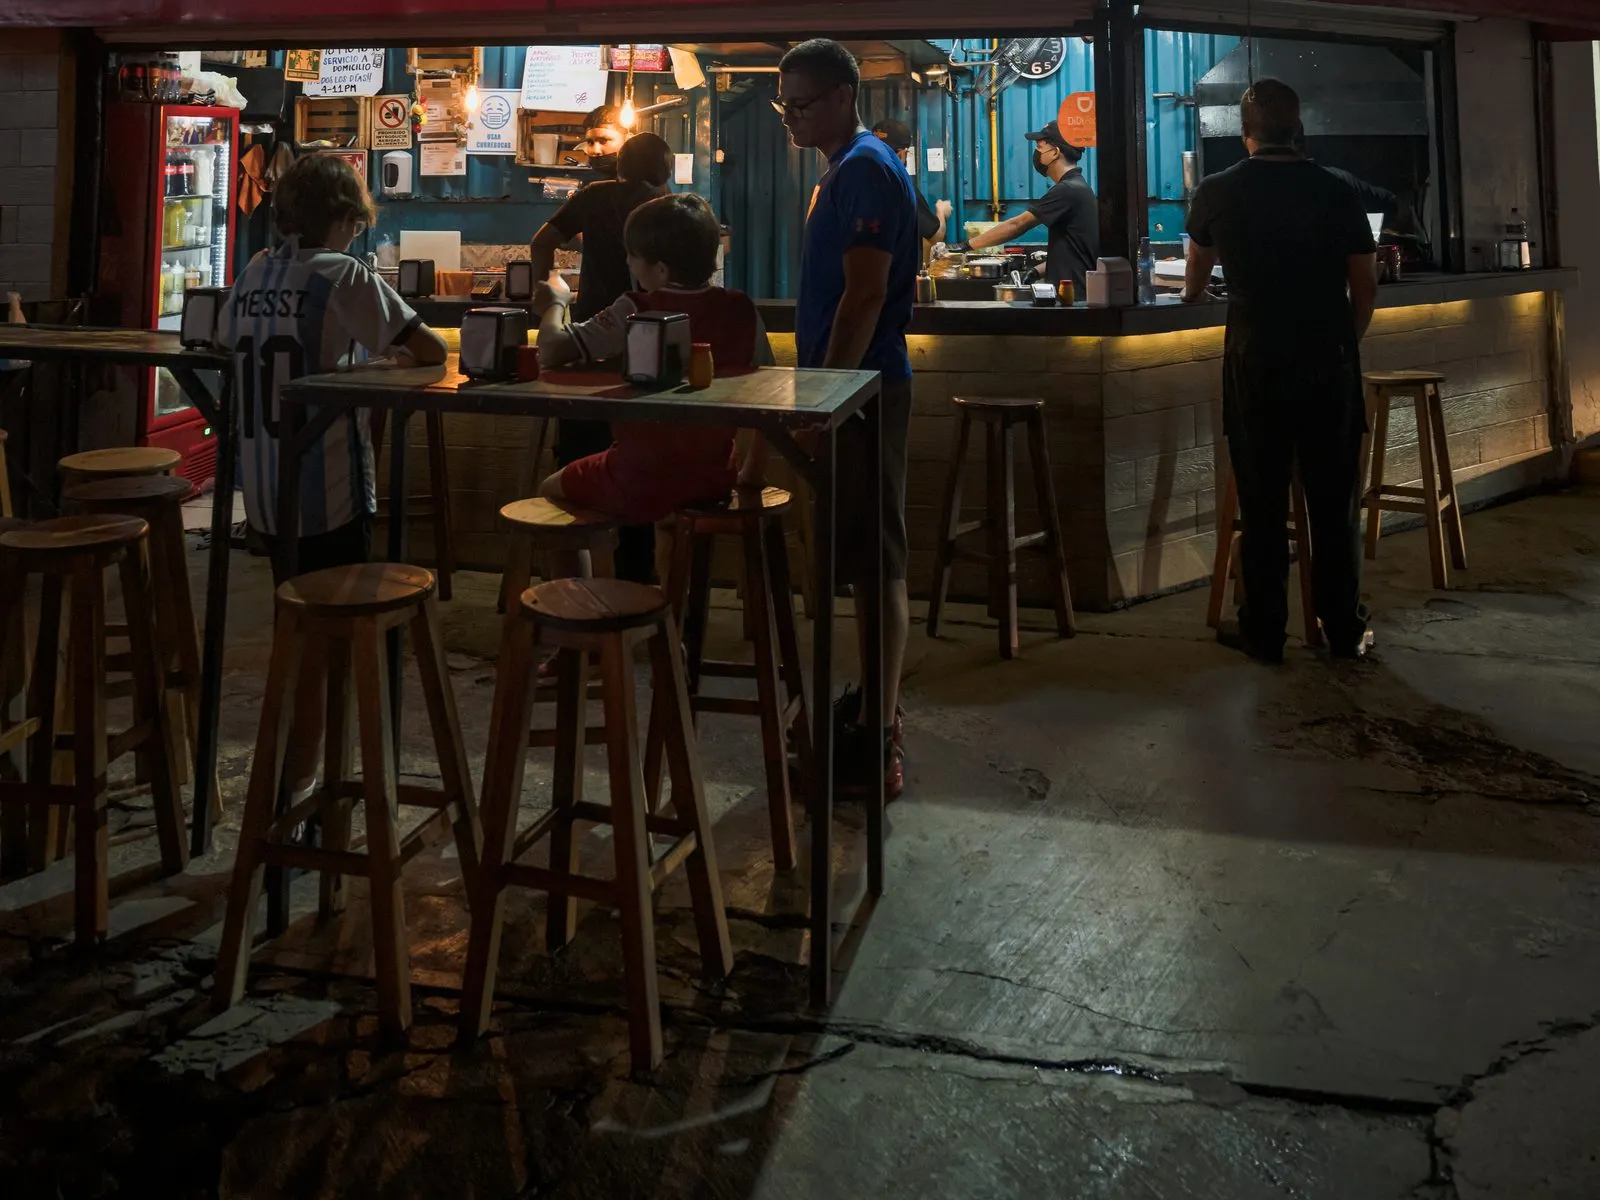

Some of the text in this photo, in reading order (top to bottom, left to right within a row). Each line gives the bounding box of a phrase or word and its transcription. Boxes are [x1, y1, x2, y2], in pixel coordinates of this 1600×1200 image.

[323, 56, 359, 65] SERVICIO
[1050, 54, 1058, 63] 4
[332, 63, 371, 73] DOMICILIO
[1031, 61, 1042, 74] 6
[1044, 61, 1052, 70] 5
[234, 289, 310, 319] MESSI
[235, 335, 307, 439] 10
